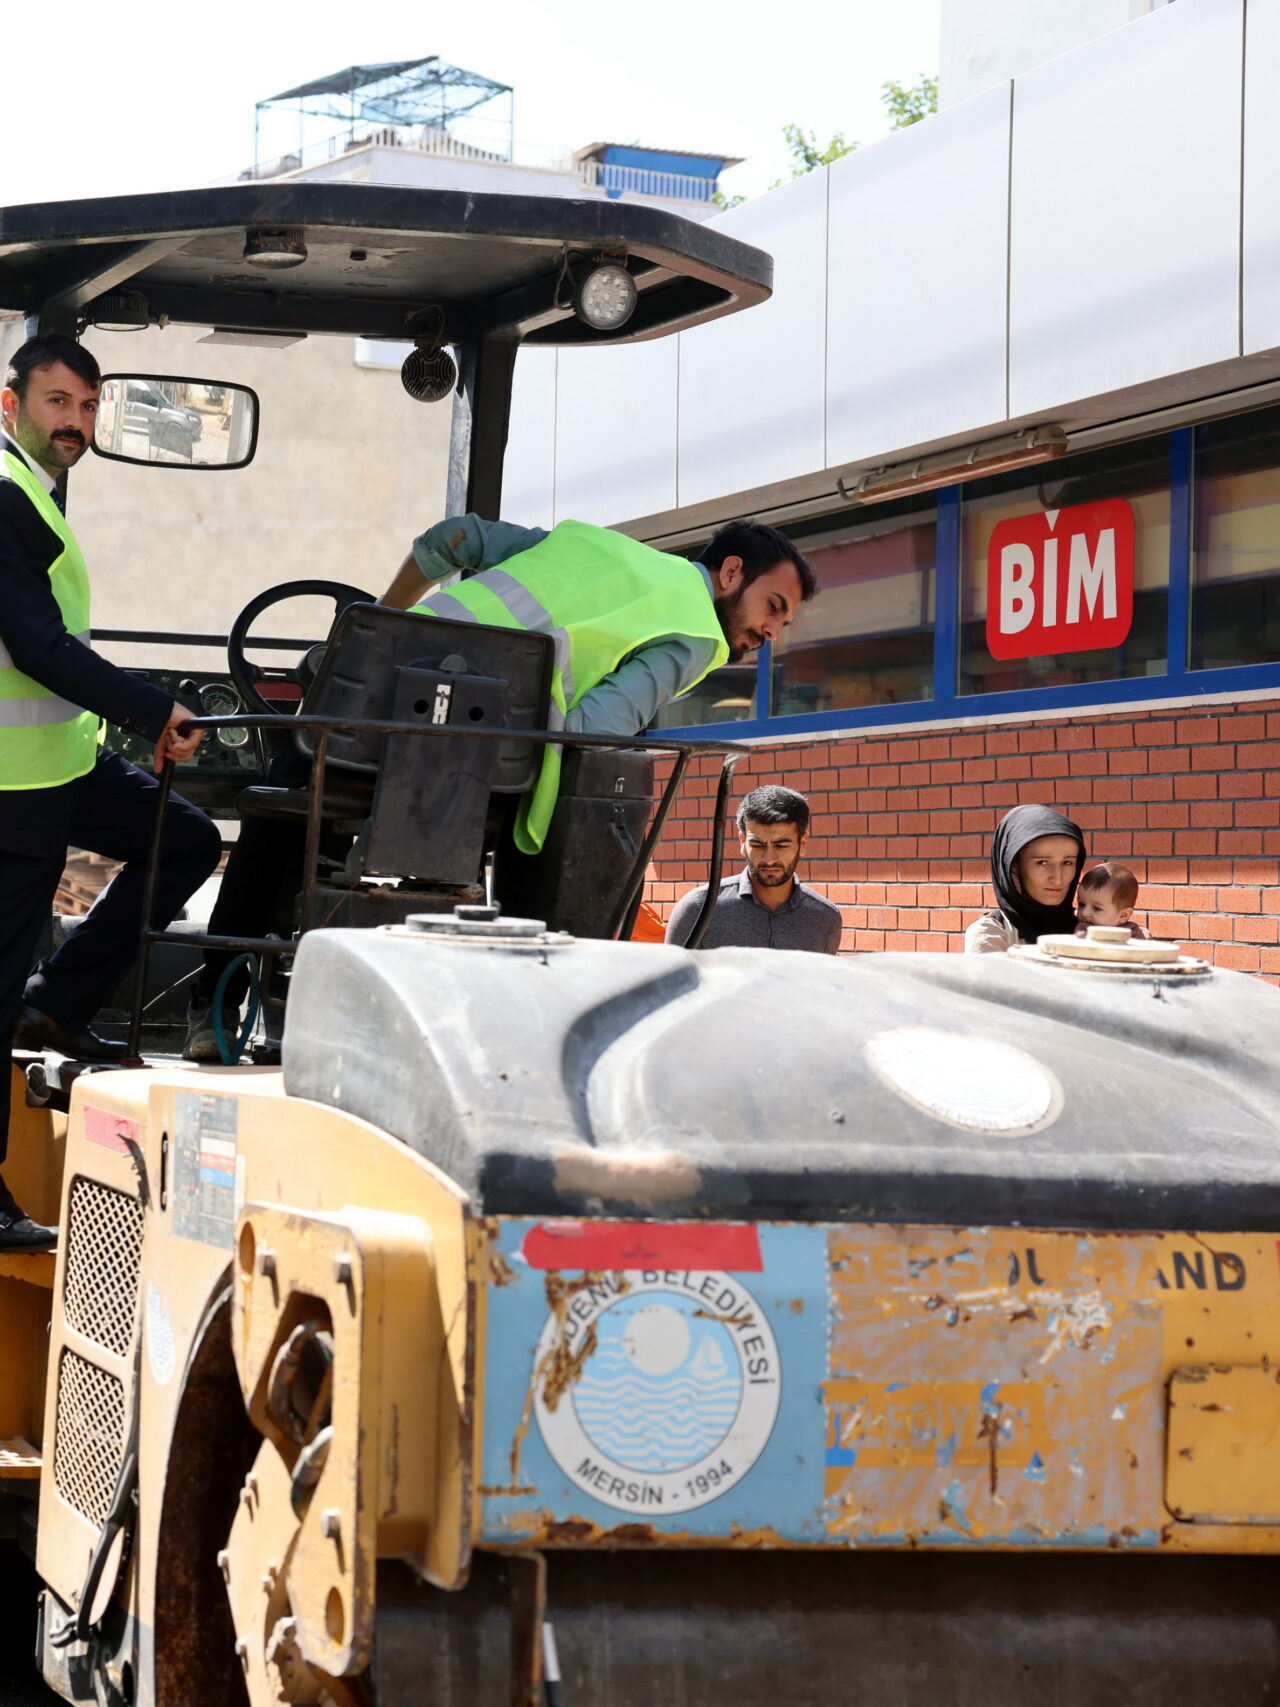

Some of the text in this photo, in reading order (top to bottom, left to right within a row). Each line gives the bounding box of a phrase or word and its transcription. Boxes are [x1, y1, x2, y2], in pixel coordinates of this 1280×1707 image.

[999, 508, 1118, 635] BİM
[642, 1270, 775, 1386] BELEDİYESİ
[575, 1457, 663, 1504] MERSİN
[685, 1459, 734, 1499] 1994
